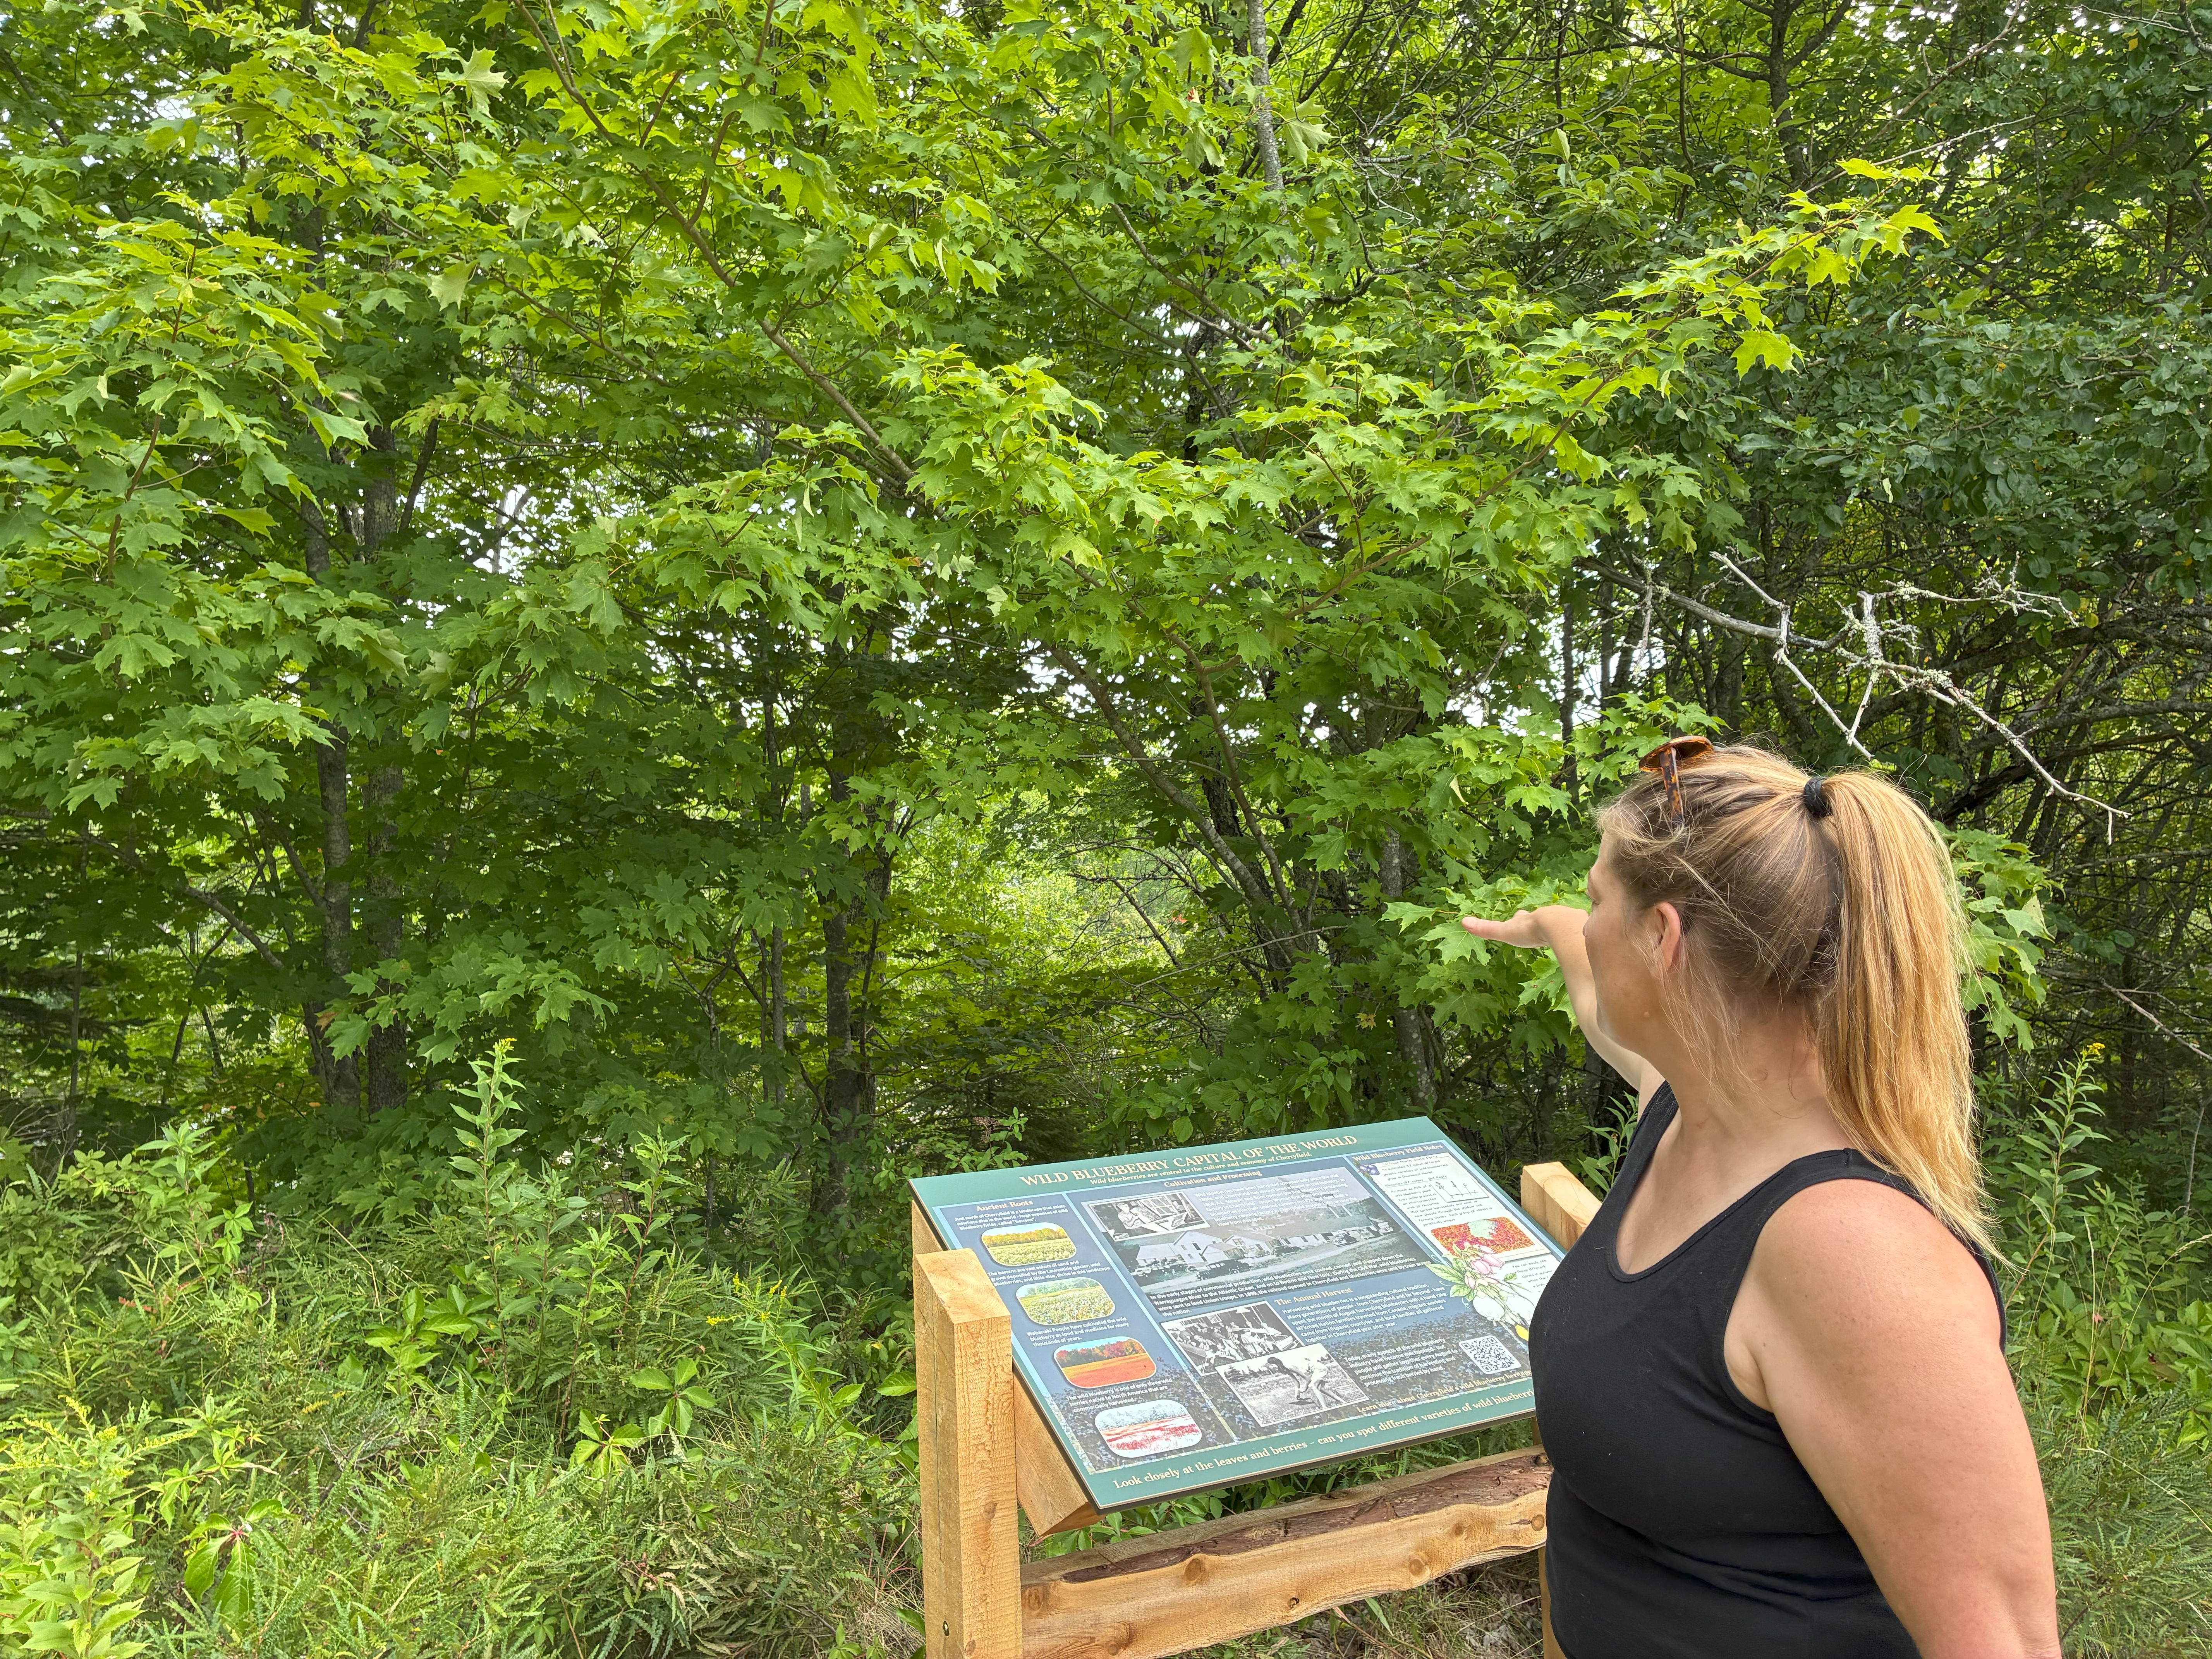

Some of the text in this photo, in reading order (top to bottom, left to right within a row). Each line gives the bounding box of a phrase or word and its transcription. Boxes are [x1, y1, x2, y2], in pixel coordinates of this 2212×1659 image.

[1020, 1135, 1359, 1186] WILD BLUEBERRY CAPITAL OF THE WORLD
[1107, 1174, 1147, 1182] blueberries
[1274, 1152, 1312, 1160] Cherryfield.
[1163, 1179, 1206, 1187] Cultivation
[1221, 1171, 1263, 1179] Processing
[975, 1203, 1009, 1211] Ancient
[1203, 1283, 1233, 1291] commercial
[1311, 1277, 1339, 1285] Cherryfield
[1291, 1292, 1322, 1302] Annual
[1321, 1287, 1353, 1297] Harvest
[1357, 1291, 1390, 1300] longstanding
[1396, 1395, 1417, 1403] about
[1415, 1386, 1460, 1399] Cherryfield's
[1473, 1376, 1508, 1386] blueberry
[1073, 1403, 1109, 1412] commercially
[1113, 1476, 1144, 1489] Look
[1144, 1469, 1183, 1482] closely
[1194, 1462, 1214, 1471] the
[1213, 1455, 1249, 1467] leaves
[1249, 1448, 1271, 1459] and
[1269, 1442, 1309, 1454] berries
[1315, 1436, 1336, 1444] can
[1335, 1432, 1355, 1442] you
[1355, 1426, 1379, 1437] spot
[1377, 1416, 1421, 1431] different
[1420, 1408, 1461, 1420] varieties
[1460, 1403, 1473, 1412] of
[1472, 1398, 1494, 1408] wild
[1492, 1389, 1535, 1404] blueberri
